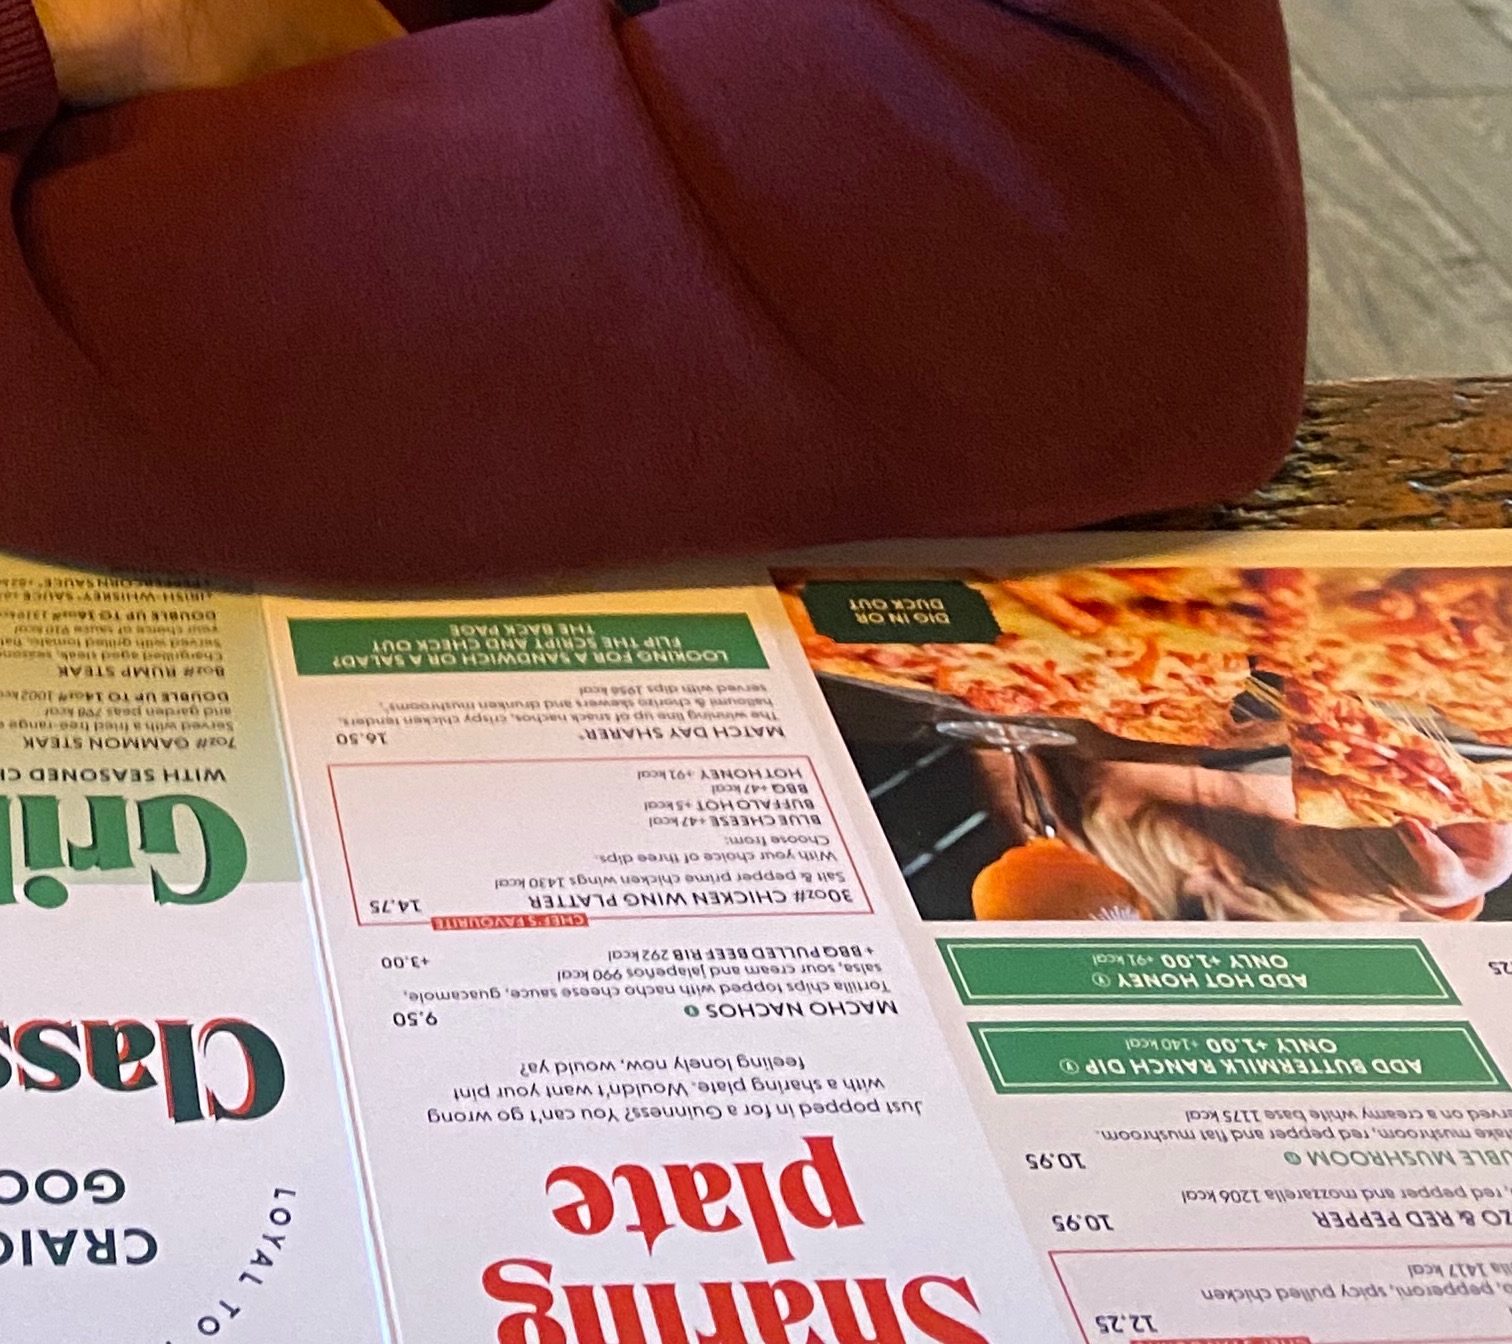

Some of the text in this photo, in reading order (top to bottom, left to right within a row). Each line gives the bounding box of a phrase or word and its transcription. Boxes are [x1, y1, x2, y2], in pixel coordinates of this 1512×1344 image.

[849, 597, 943, 610] DUCK OUT
[855, 612, 950, 624] DIG IN OR
[449, 623, 595, 637] THE BACK PAGE
[372, 636, 680, 652] FLIP THE SCRIPT AND CHECK OUT
[332, 650, 728, 668] LOOKING FOR A SANDWICH OR A SALAD?
[336, 732, 387, 746] 16.50
[669, 727, 707, 739] DAY
[712, 725, 784, 738] MATCH
[29, 768, 154, 782] SEASONED
[163, 767, 227, 783] WITH
[370, 899, 421, 914] 14.75
[528, 889, 853, 908] 30oz# CHICKEN WING PLATTER
[1161, 954, 1288, 968] ONLY +1.00
[1118, 973, 1308, 987] ADD HOT HONEY
[706, 1000, 898, 1018] MACHO NACHOS
[393, 1011, 438, 1027] 9.50
[1207, 1038, 1336, 1053] ONLY +1.00
[520, 1055, 805, 1077] feeling lonely now, would ya?
[1086, 1059, 1422, 1074] ADD BUTTERMILK RANCH DIP
[453, 1077, 885, 1101] with a sharing plate. Wouldn't want your pint
[427, 1100, 922, 1125] Just popped in for a Guinness? You can't go wrong
[1026, 1153, 1086, 1169] 10.95
[1308, 1150, 1453, 1166] MUSHROOM
[545, 1136, 864, 1264] plate
[1052, 1214, 1111, 1231] 10.95
[1313, 1211, 1400, 1228] PEPPER
[1406, 1210, 1454, 1227] RED
[1459, 1211, 1475, 1227] &
[197, 1188, 296, 1337] LOYAL TO
[482, 1258, 988, 1344] Sharing
[1095, 1315, 1157, 1333] 12.25
